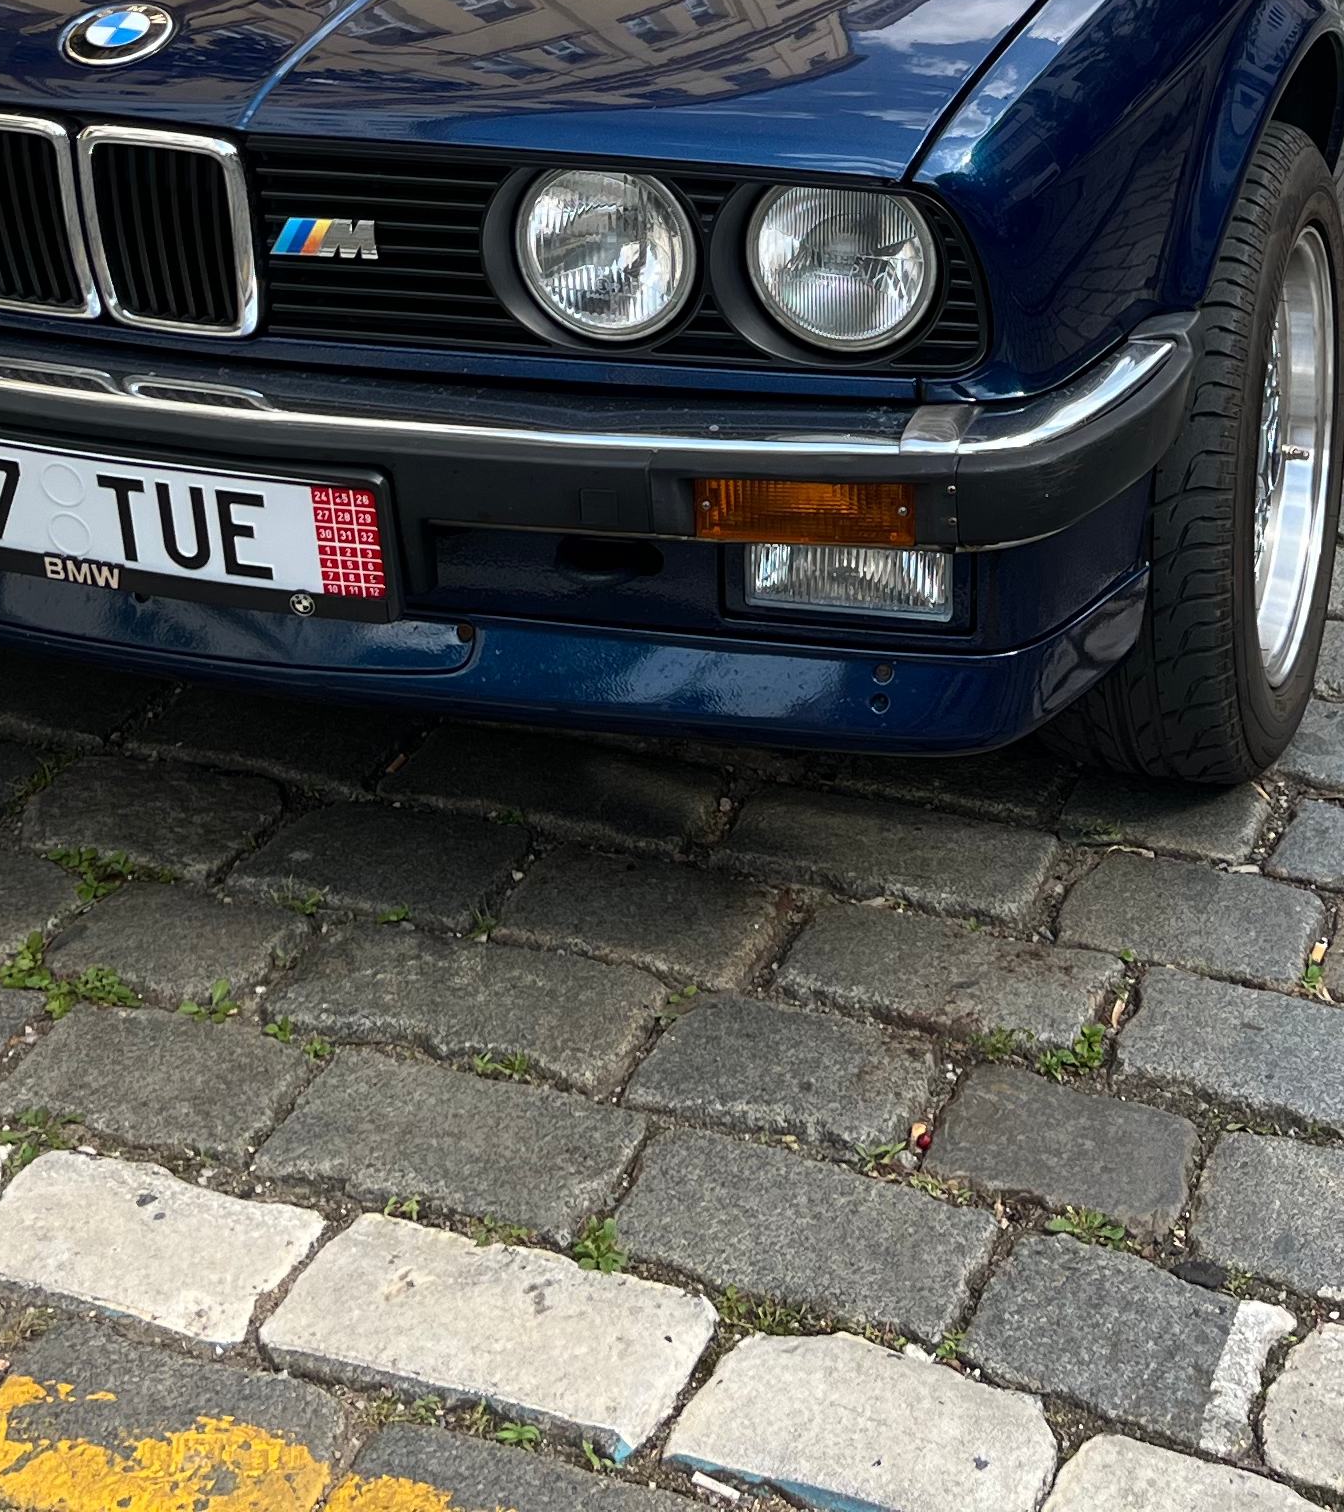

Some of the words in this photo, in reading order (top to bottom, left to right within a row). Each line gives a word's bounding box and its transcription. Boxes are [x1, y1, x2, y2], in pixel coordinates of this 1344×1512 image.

[318, 218, 378, 259] M
[314, 491, 327, 501] 24
[356, 495, 369, 505] 26
[316, 510, 329, 520] 27
[337, 512, 350, 522] 28
[358, 513, 372, 523] 29
[96, 473, 274, 581] TUE
[319, 528, 332, 539] 30
[340, 530, 352, 540] 31
[360, 532, 374, 542] 32
[325, 546, 330, 554] 1
[345, 548, 351, 556] 2
[366, 550, 372, 558] 3
[326, 559, 332, 567] 4
[367, 562, 374, 570] 6
[44, 556, 119, 589] BMW
[328, 572, 334, 580] 7
[328, 584, 338, 593] 10
[349, 586, 358, 594] 11
[369, 587, 379, 596] 12
